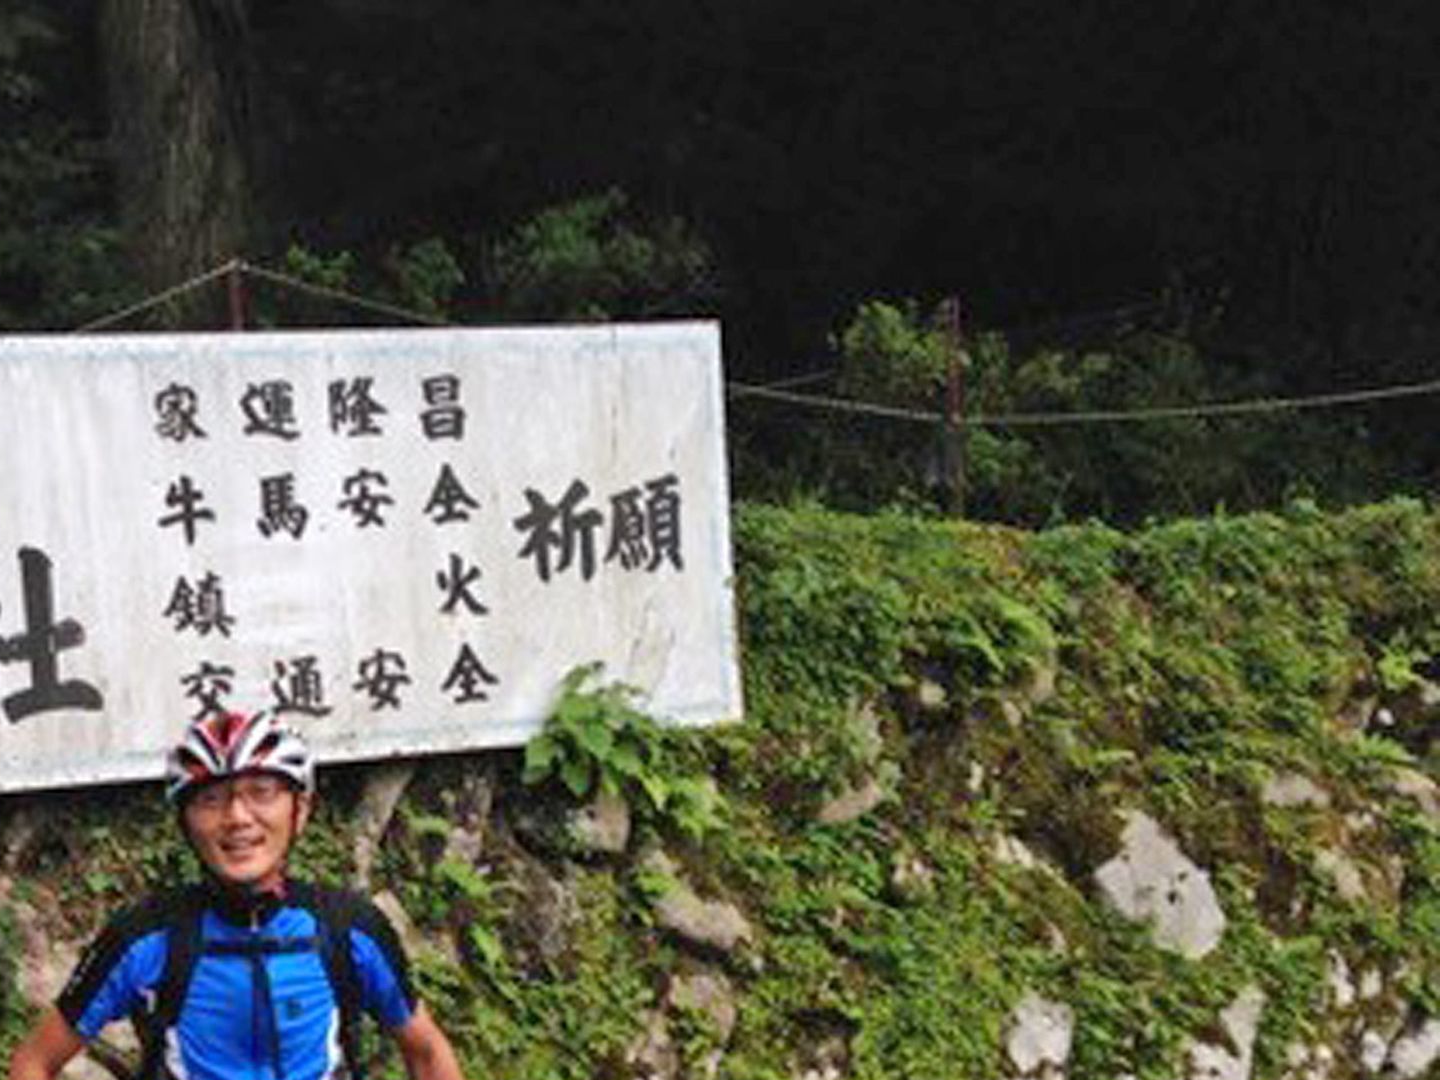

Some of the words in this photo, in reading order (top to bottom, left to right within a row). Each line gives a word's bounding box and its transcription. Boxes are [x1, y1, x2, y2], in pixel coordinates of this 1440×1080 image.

[154, 373, 467, 443] 家運隆昌
[158, 463, 481, 545] 牛馬安全
[514, 473, 685, 583] 祈願
[180, 643, 500, 721] 交通安全
